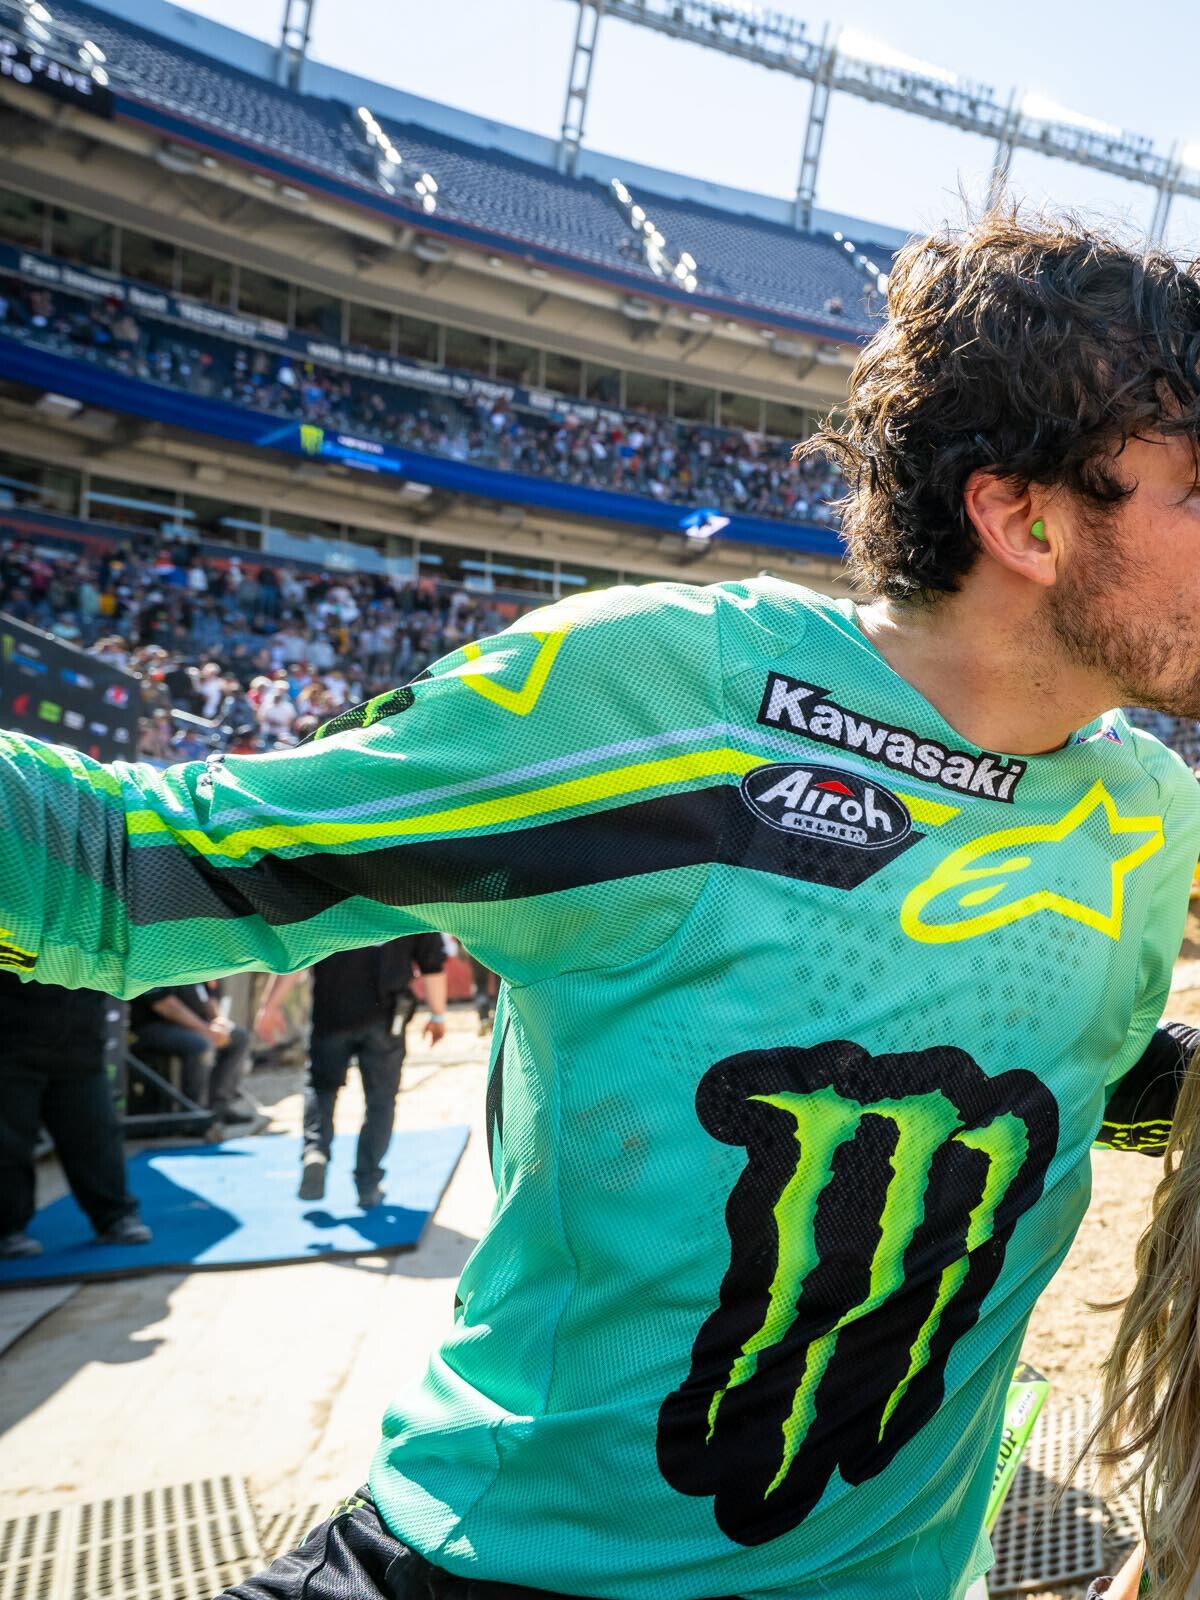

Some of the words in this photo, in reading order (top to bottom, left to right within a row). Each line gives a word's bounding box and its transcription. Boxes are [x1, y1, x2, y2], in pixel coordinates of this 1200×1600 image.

[764, 678, 1021, 801] Kawasaki
[754, 769, 893, 833] Airoh
[793, 817, 864, 839] HELMET
